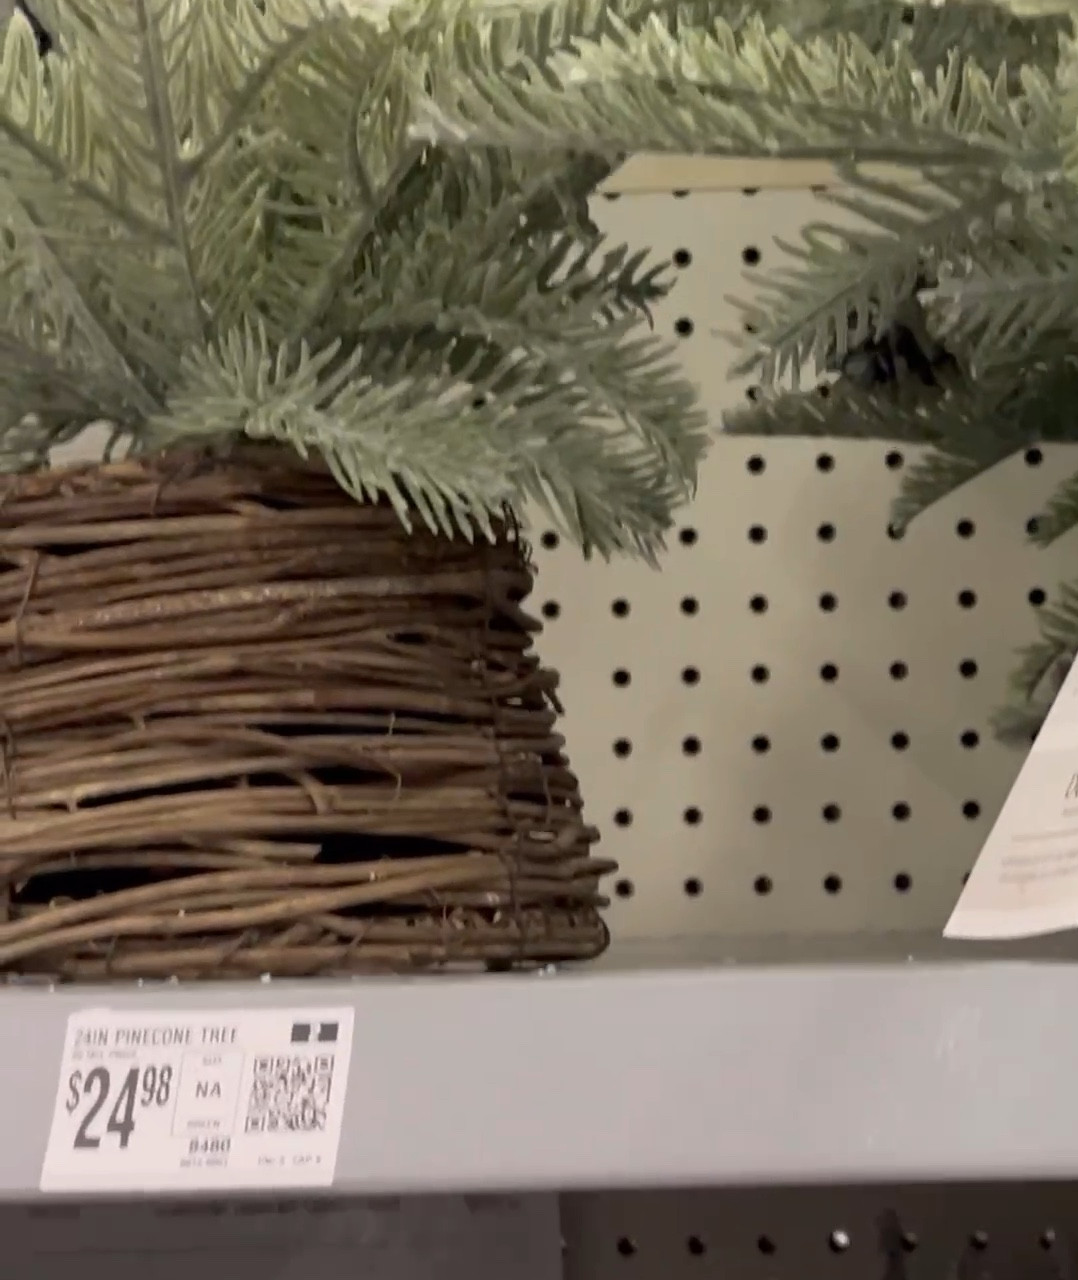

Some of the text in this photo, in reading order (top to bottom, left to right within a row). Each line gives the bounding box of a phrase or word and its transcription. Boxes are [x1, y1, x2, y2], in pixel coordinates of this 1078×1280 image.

[115, 1026, 191, 1046] PINECONE
[201, 1026, 238, 1044] TREE
[195, 1080, 222, 1099] NA
